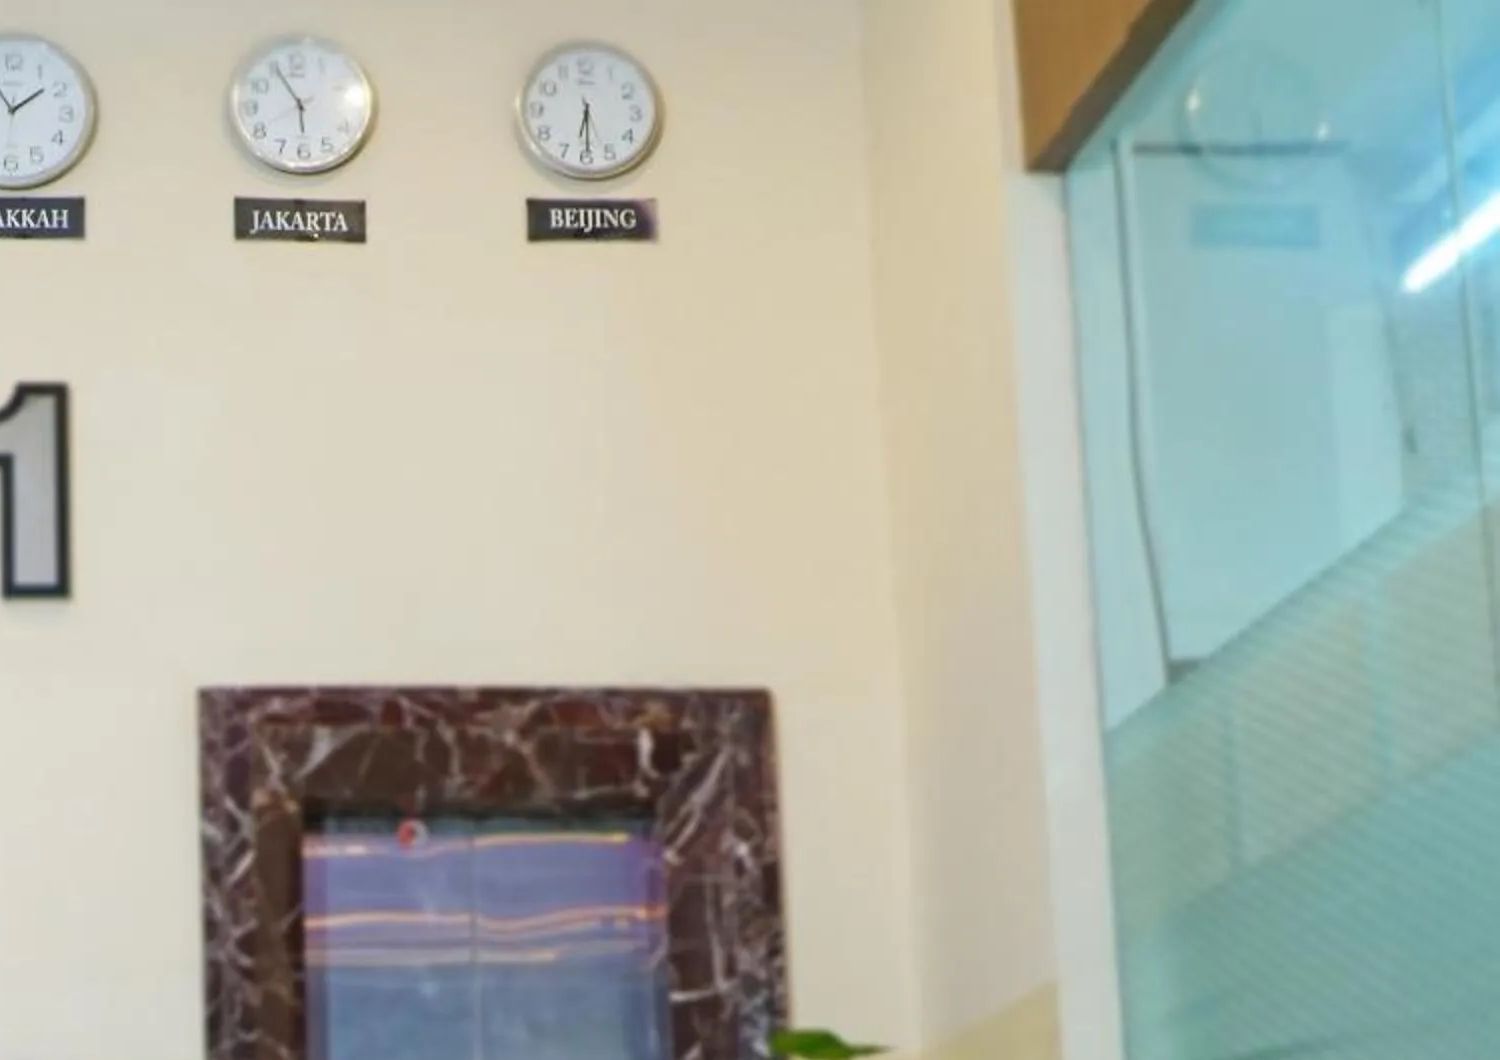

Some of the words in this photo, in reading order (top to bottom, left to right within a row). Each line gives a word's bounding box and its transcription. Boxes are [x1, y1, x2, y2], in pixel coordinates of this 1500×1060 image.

[4, 53, 22, 72] 12
[52, 80, 68, 98] 2
[620, 79, 636, 101] 2
[59, 104, 74, 123] 3
[628, 103, 643, 122] 3
[51, 129, 64, 145] 4
[252, 122, 267, 140] 8
[537, 125, 552, 142] 8
[620, 127, 634, 145] 4
[274, 138, 287, 155] 7
[297, 143, 311, 160] 6
[320, 136, 335, 154] 5
[558, 142, 571, 159] 7
[603, 142, 617, 161] 5
[3, 154, 19, 173] 6
[29, 146, 44, 164] 5
[579, 149, 595, 165] 6
[249, 210, 348, 235] JAKARTA
[549, 207, 637, 233] BEIJING
